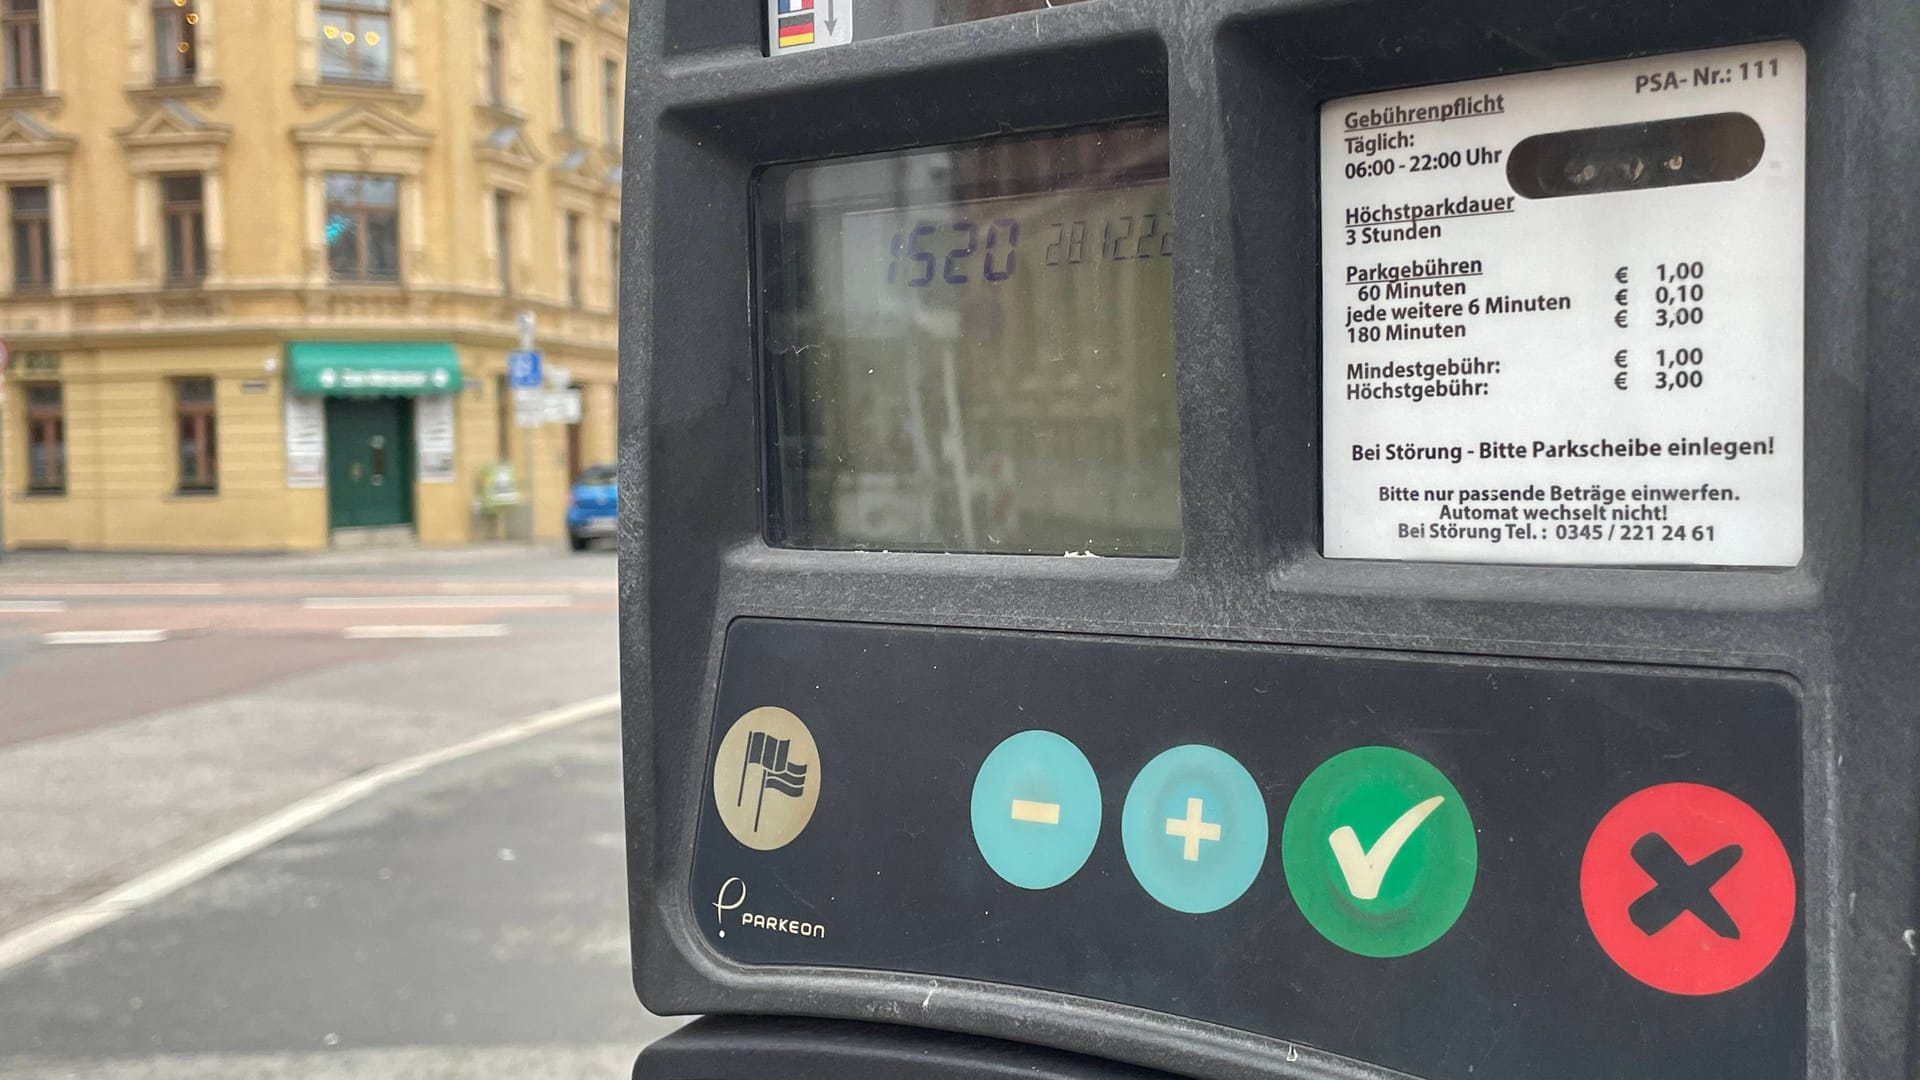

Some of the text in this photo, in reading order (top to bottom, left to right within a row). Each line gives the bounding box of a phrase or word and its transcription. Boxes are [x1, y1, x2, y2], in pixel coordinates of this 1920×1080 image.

[1693, 66, 1732, 87] Nr.:
[1740, 58, 1778, 80] 111
[1344, 94, 1505, 128] Gebührenpflicht
[1344, 131, 1415, 157] Täglich:
[1344, 159, 1396, 180] 06:00
[1409, 150, 1462, 173] 22:00
[1465, 147, 1503, 167] Uhr
[1345, 195, 1516, 226] Höchstparkdauer
[1345, 223, 1442, 246] 3 Stunden
[887, 218, 1020, 288] 1520
[1345, 257, 1483, 285] Parkgebühren
[1614, 261, 1705, 285] € 1,00
[1357, 281, 1467, 303] 60 Minuten
[1614, 283, 1705, 307] € 0,10
[1344, 294, 1572, 327] jede weitere 6 Minuten
[1613, 306, 1704, 329] € 3,00
[1347, 322, 1467, 344] 180 Minuten
[1346, 357, 1501, 381] Mindestgebühr:
[1613, 347, 1704, 370] € 1,00
[1346, 380, 1489, 402] Höchstgebühr:
[1613, 369, 1704, 392] € 3,00
[1351, 444, 1381, 462] Bei
[1385, 442, 1463, 465] Störung
[1479, 440, 1528, 460] Bitte
[1532, 437, 1662, 459] Parkscheibe
[1667, 435, 1776, 461] einlegen!
[1378, 482, 1741, 506] Bitte nur passende Beträge einwerfen.
[1439, 503, 1668, 522] Automat wechselt nicht!
[1397, 522, 1426, 539] Bei
[1429, 522, 1502, 544] Störung
[1555, 523, 1603, 541] 0345
[1607, 523, 1616, 547] /
[1619, 524, 1655, 541] 221
[1661, 524, 1687, 542] 24
[1691, 524, 1716, 543] 61
[742, 912, 826, 939] PARKEON
